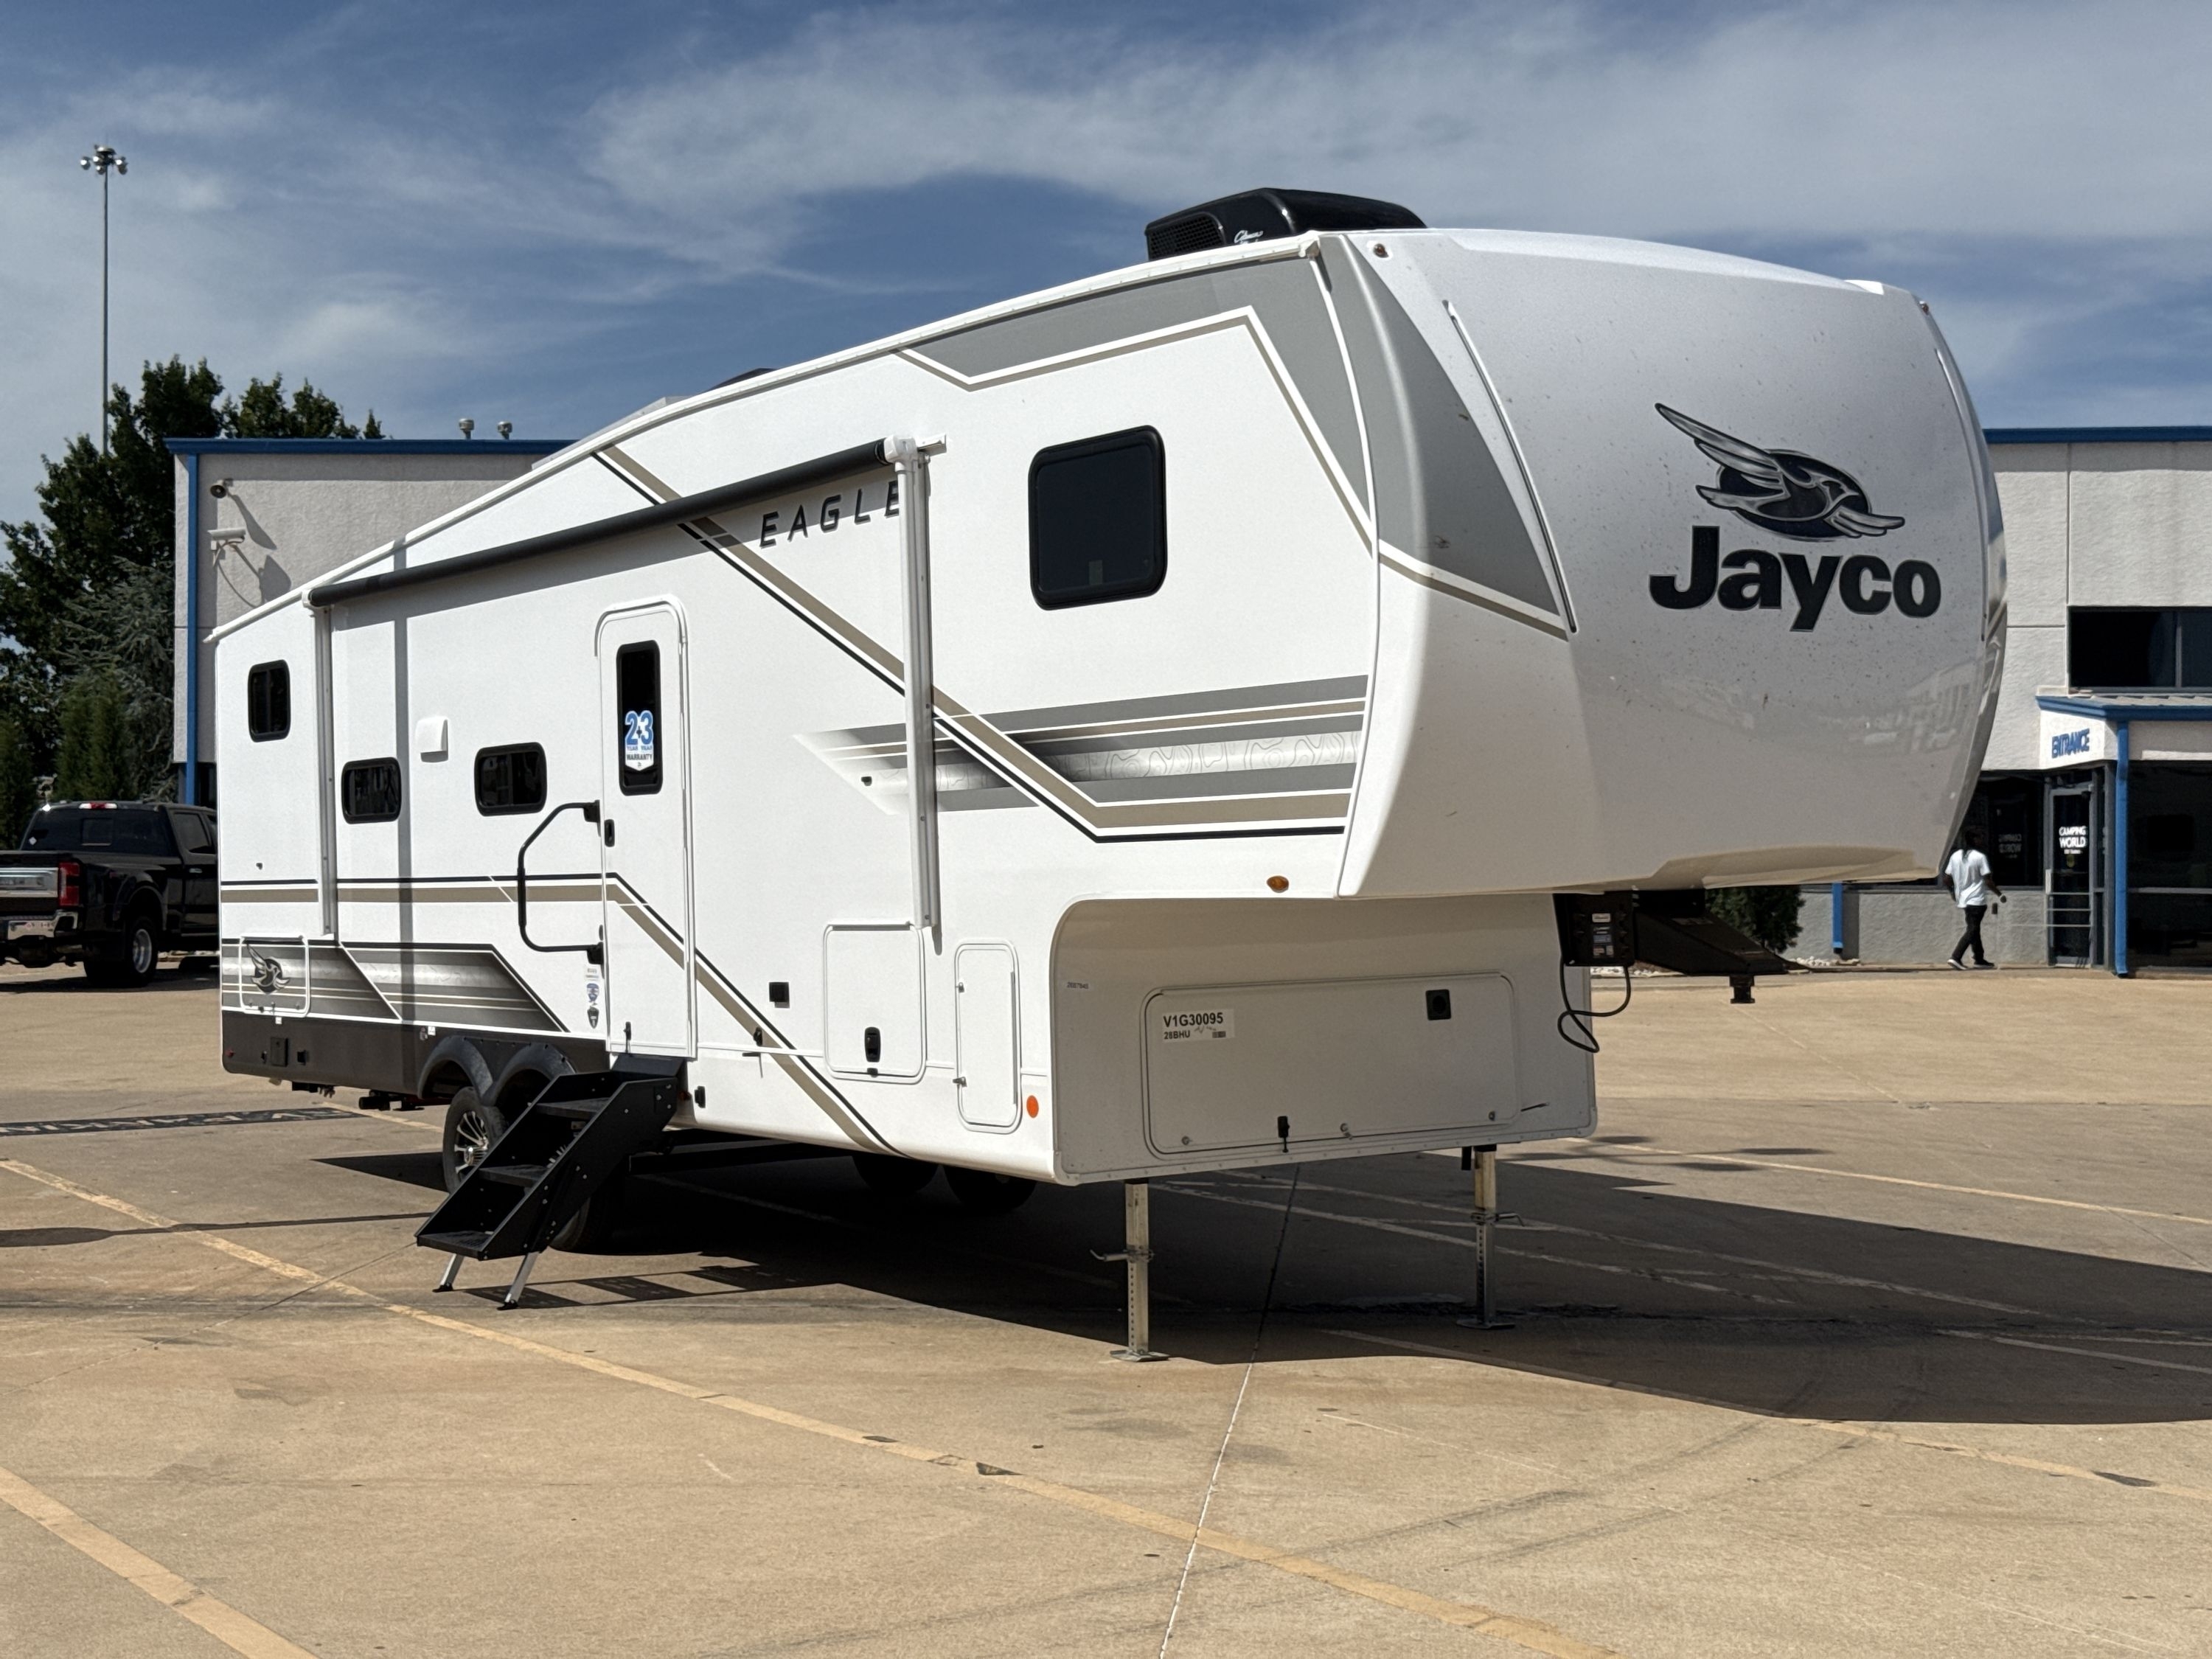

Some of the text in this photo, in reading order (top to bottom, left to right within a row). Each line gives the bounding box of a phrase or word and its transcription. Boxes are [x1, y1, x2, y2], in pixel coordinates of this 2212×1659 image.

[759, 480, 900, 548] EAGLE
[1649, 525, 1941, 632] Jayco
[2051, 727, 2090, 759] ENTRANCE
[2059, 826, 2087, 836] CAMPING
[2059, 836, 2086, 848] WORLD
[1163, 1012, 1224, 1028] V1G30095
[1164, 1030, 1191, 1040] 28BHU
